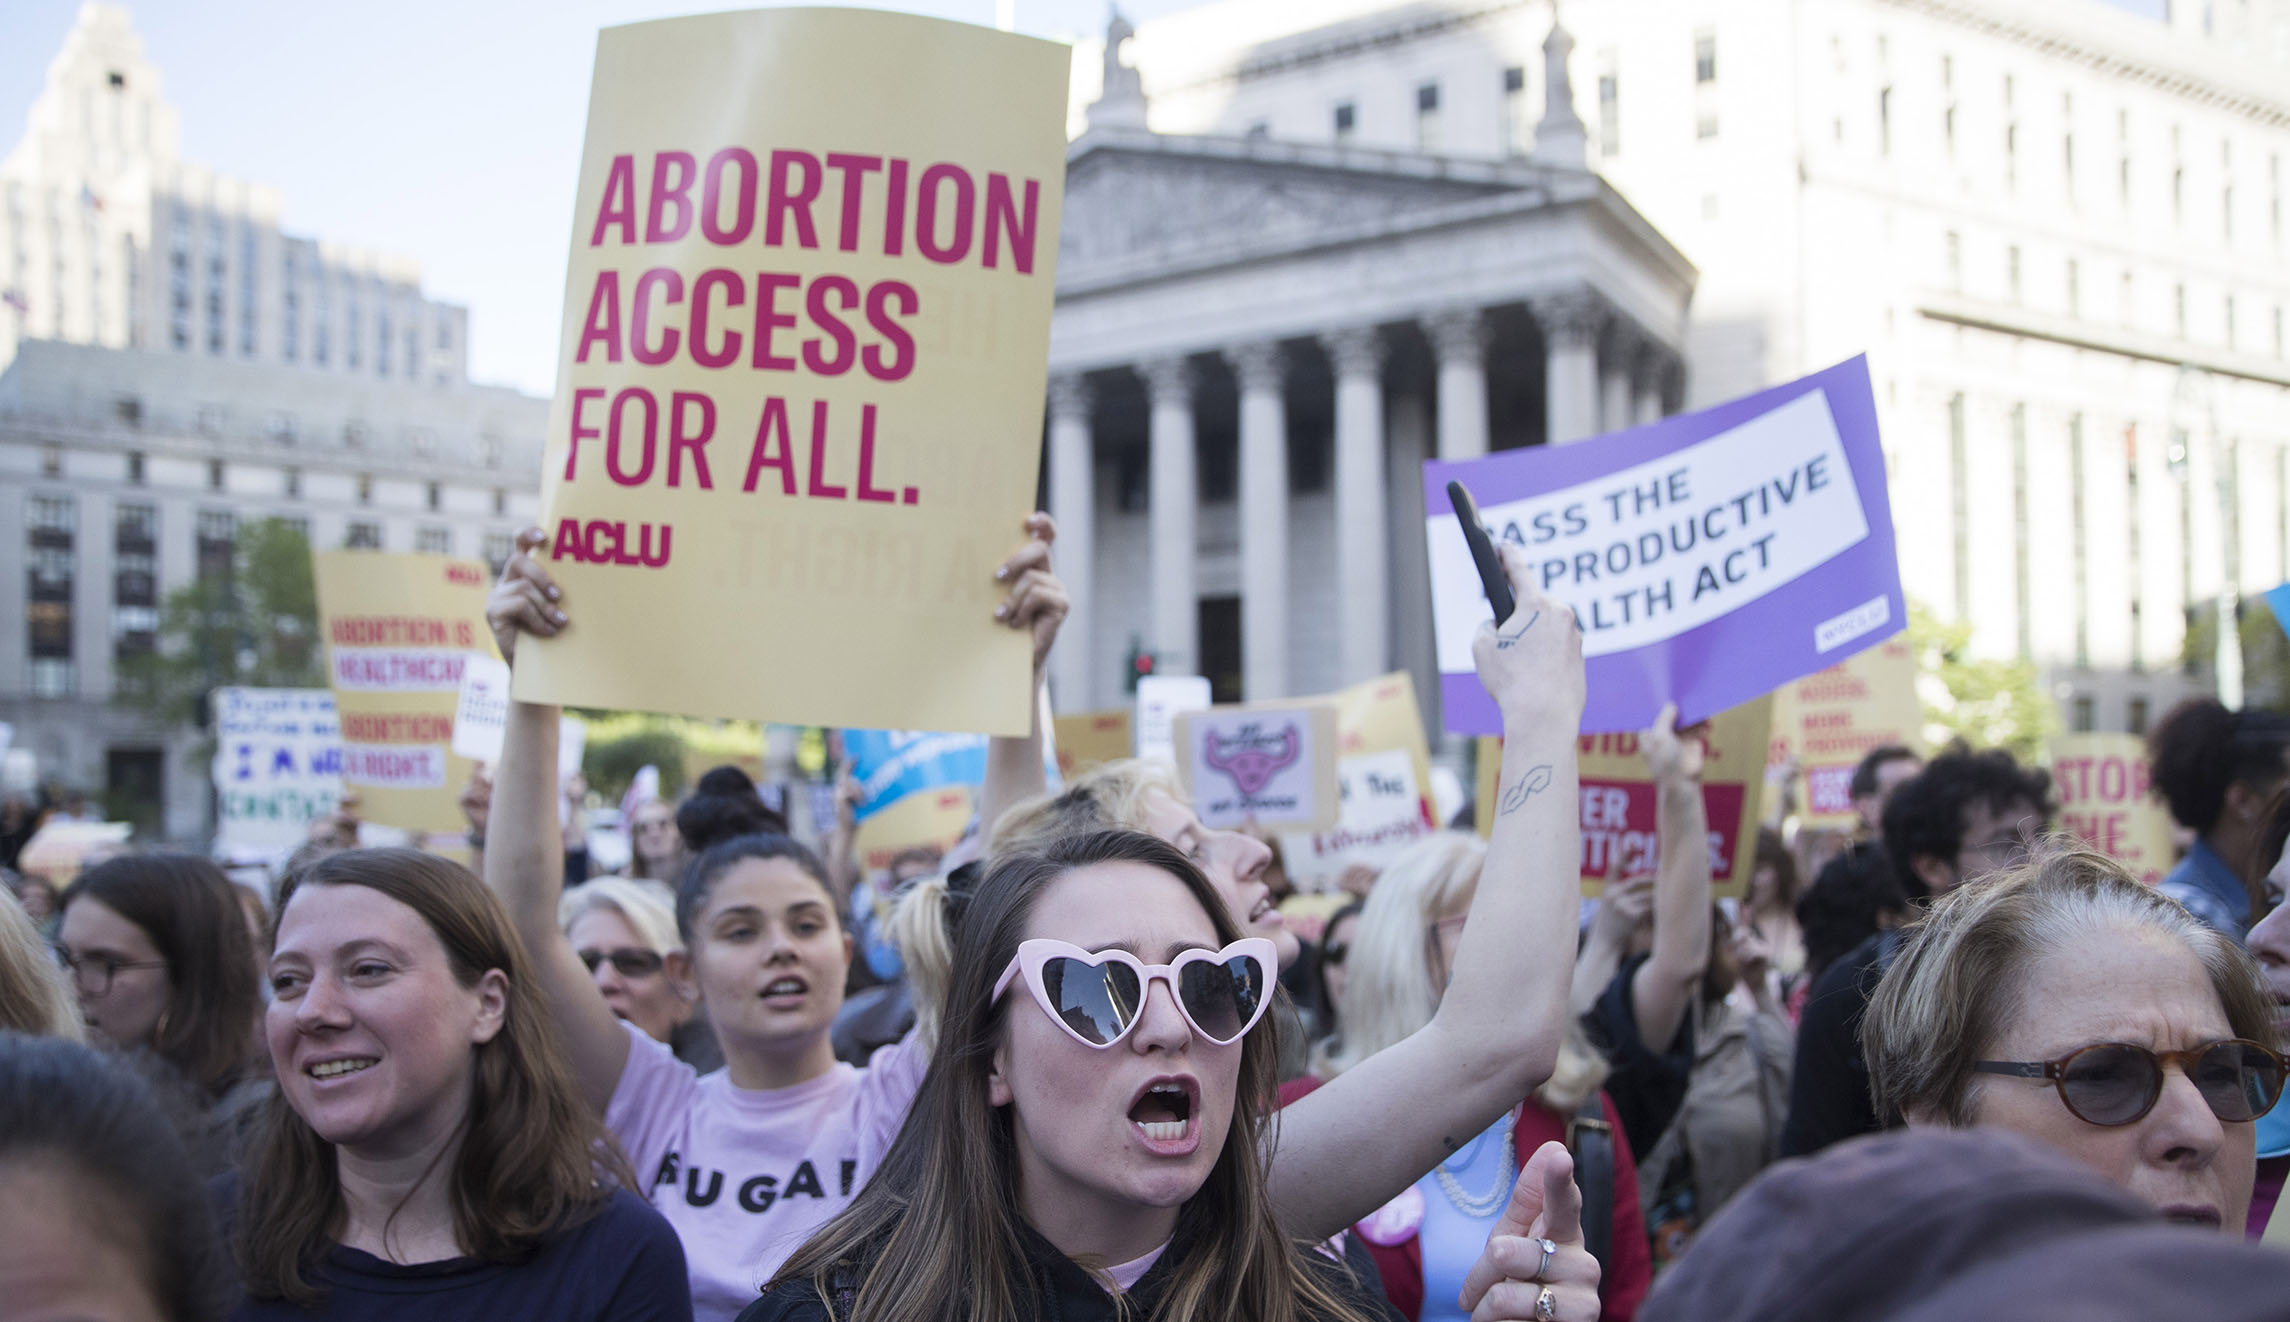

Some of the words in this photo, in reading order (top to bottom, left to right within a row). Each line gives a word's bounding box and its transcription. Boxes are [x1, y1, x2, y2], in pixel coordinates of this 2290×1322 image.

[590, 146, 1040, 276] ABORTION
[575, 268, 920, 382] ACCESS
[564, 386, 718, 491] FOR
[741, 396, 920, 506] ALL.
[551, 517, 673, 570] ACLU
[1487, 503, 1588, 546] ASS
[1604, 467, 1692, 523] THE
[1528, 453, 1831, 590] PRODUCTIVE
[331, 617, 448, 645] ABORTION
[1570, 580, 1675, 634] LTH
[1694, 532, 1777, 601] ACT
[2055, 756, 2153, 805] STOP
